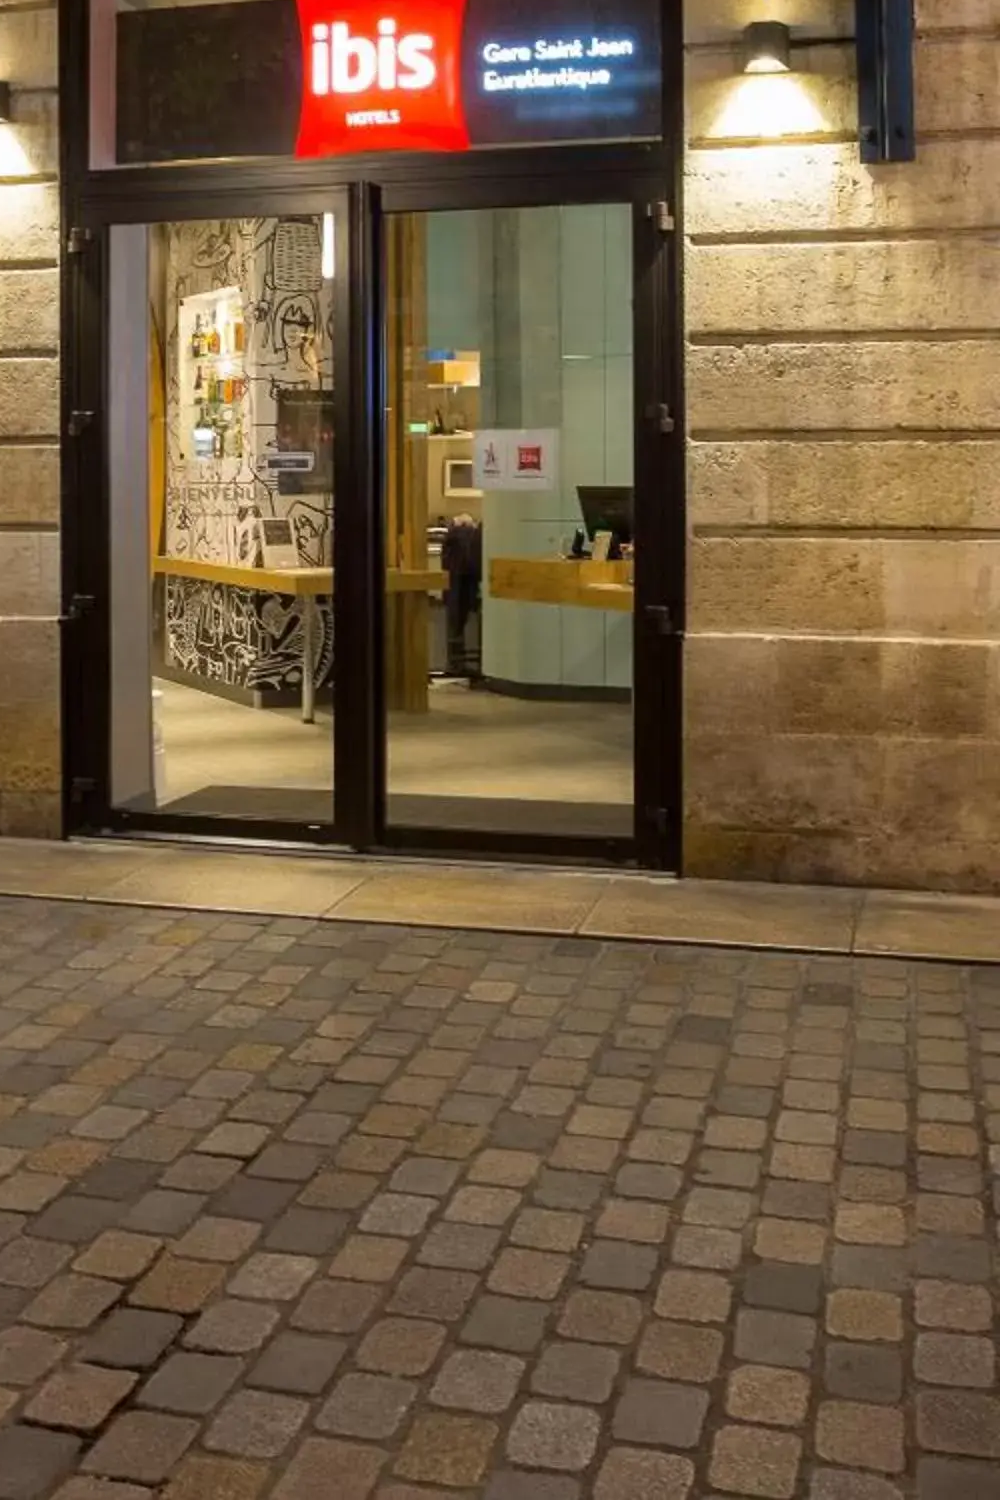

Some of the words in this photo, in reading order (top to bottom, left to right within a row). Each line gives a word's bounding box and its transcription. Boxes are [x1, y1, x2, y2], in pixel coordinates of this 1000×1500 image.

[312, 18, 436, 96] ibis
[483, 43, 531, 63] Gare
[535, 39, 583, 60] Saint
[587, 37, 633, 57] Jean
[345, 109, 401, 127] HOTELS
